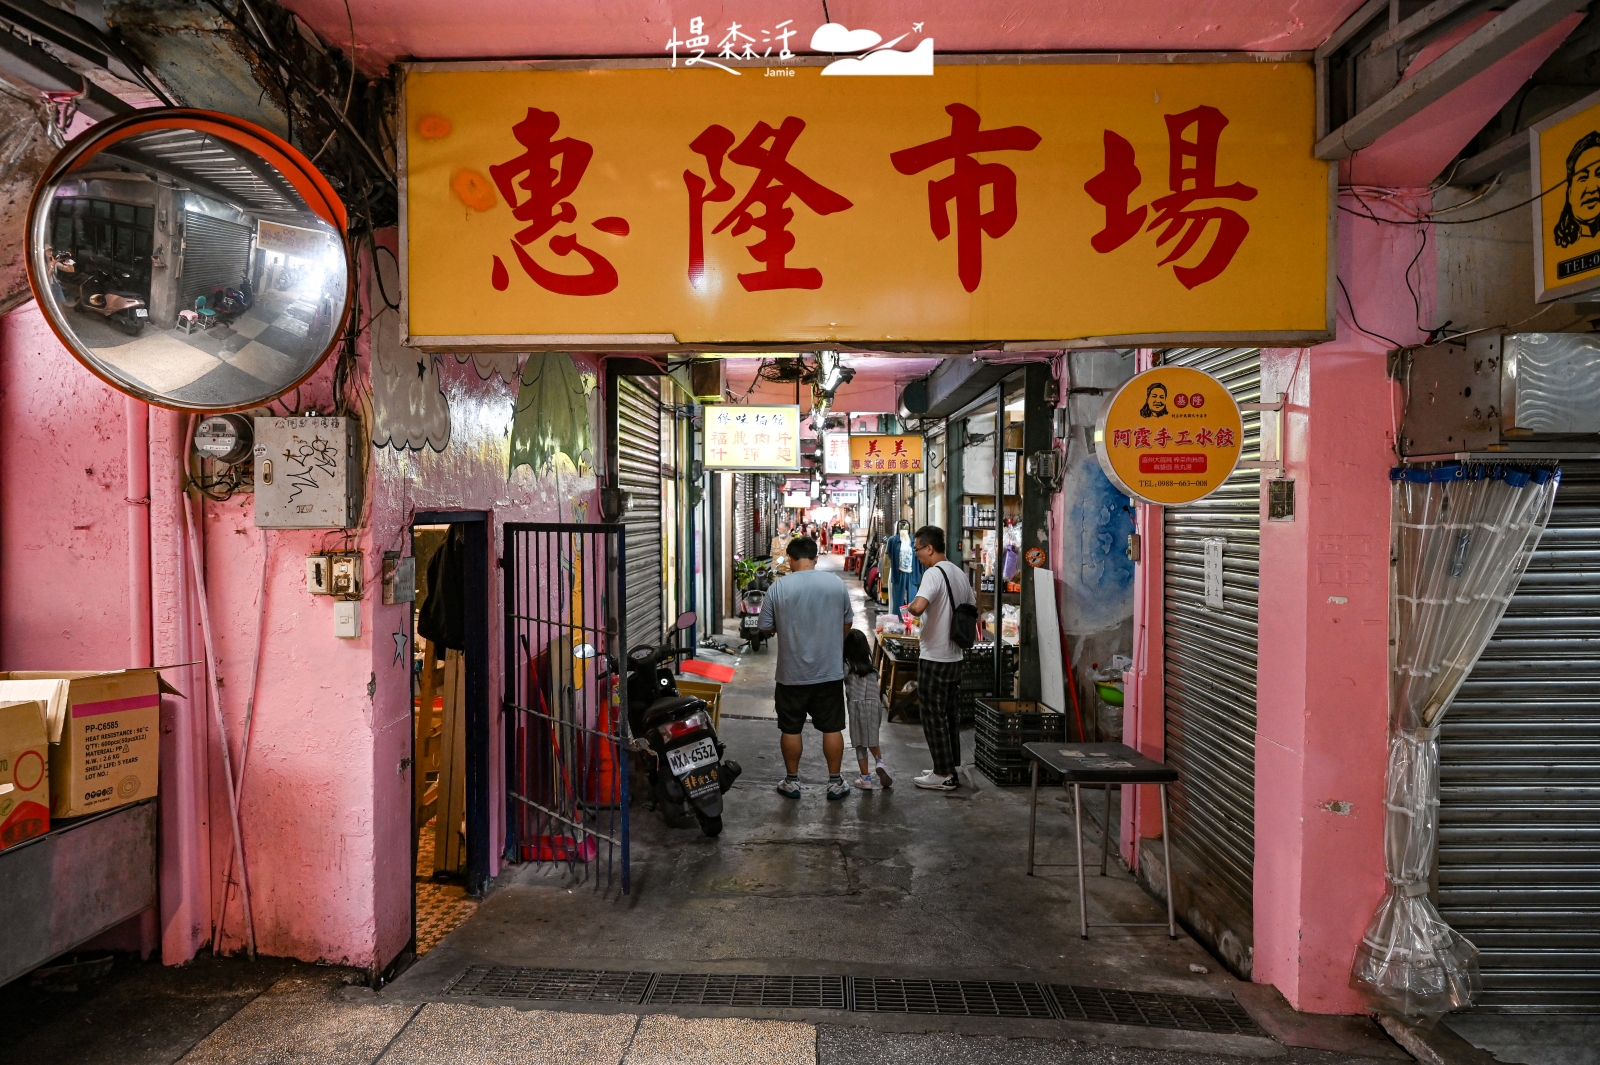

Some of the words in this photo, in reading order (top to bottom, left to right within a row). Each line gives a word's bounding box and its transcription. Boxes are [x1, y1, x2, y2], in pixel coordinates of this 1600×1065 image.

[488, 102, 1258, 296] 惠隆市場
[1176, 395, 1203, 407] 基隆
[711, 430, 792, 446] 福鼎肉片
[1112, 427, 1235, 448] 阿霞手工水餃
[711, 446, 792, 462] 什錦麵
[865, 439, 908, 457] 美美
[851, 459, 921, 470] 專業服飾修改
[85, 721, 119, 733] PP-C6585
[101, 729, 132, 740] RESISTANCE
[85, 748, 115, 757] MATERIAL:
[669, 744, 716, 770] MXA-6532
